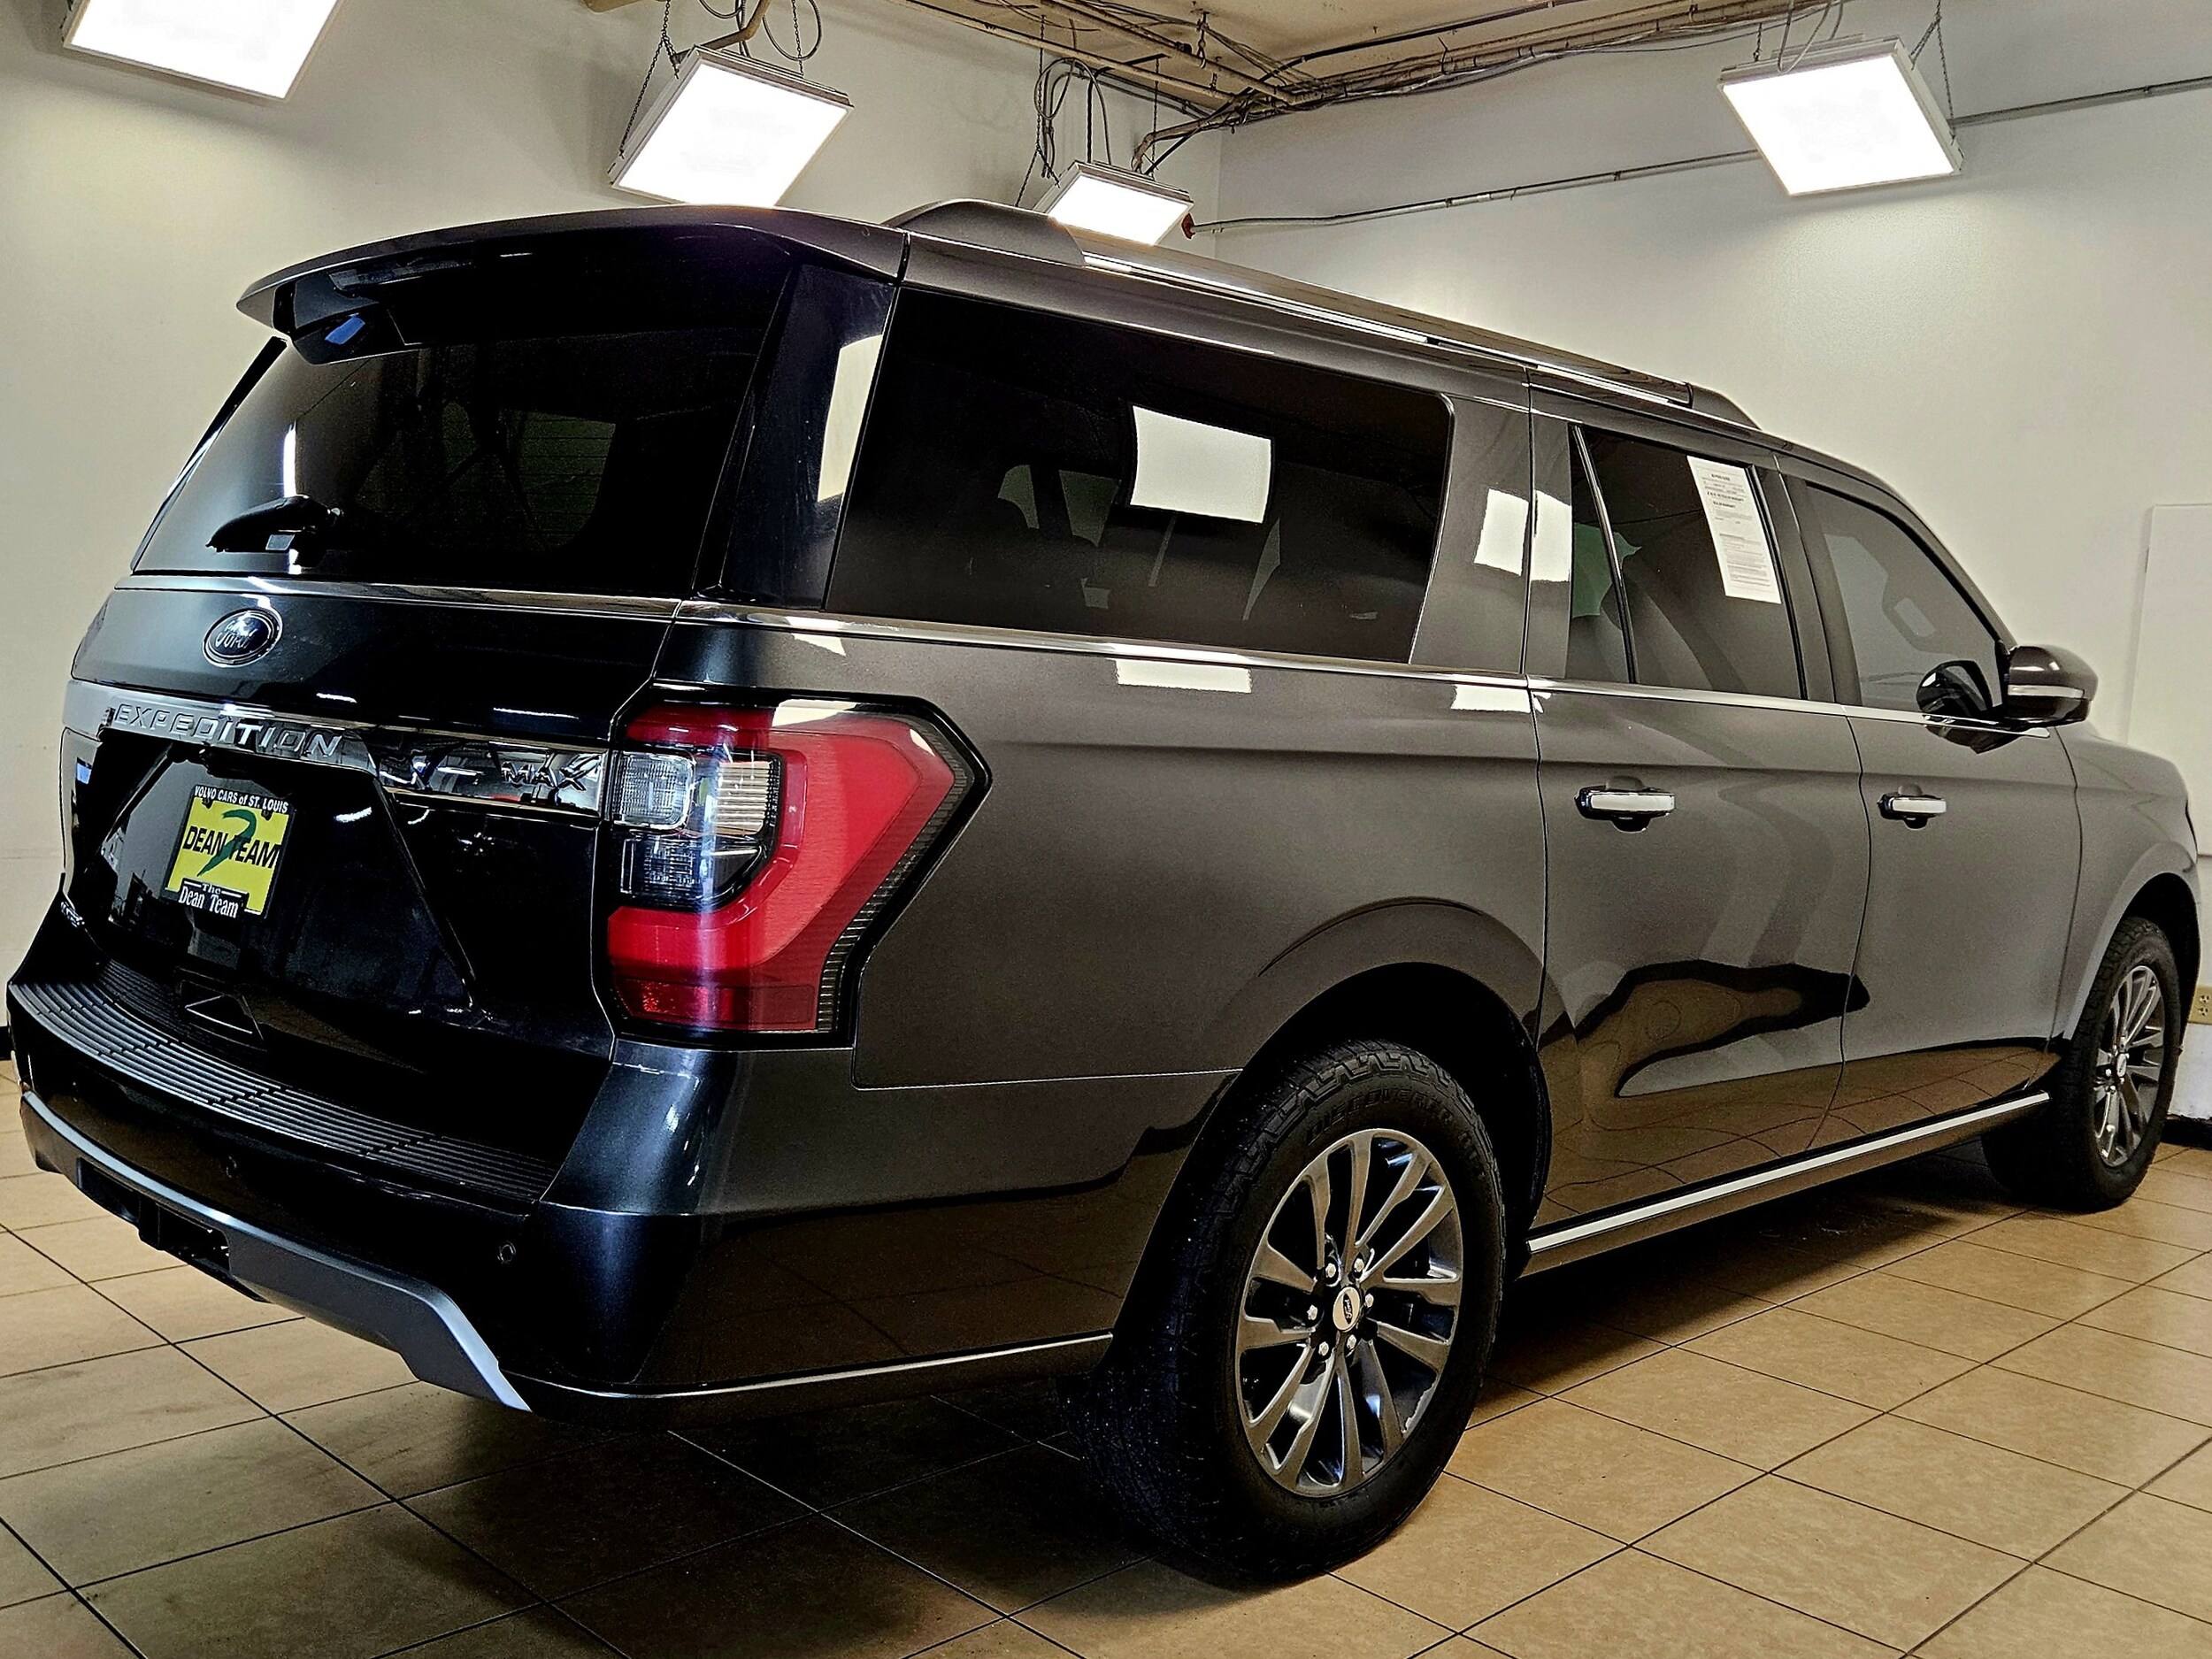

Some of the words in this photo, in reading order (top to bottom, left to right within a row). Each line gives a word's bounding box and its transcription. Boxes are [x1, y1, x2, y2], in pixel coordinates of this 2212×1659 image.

[215, 619, 258, 649] Ford
[114, 703, 342, 757] EXPEDITION
[501, 761, 587, 791] MAX
[195, 785, 217, 800] VOLVO
[218, 789, 238, 803] CARS
[238, 794, 249, 805] of
[249, 796, 261, 808] ST.
[262, 798, 289, 813] LOUIS
[182, 826, 228, 858] DEAN
[228, 835, 282, 869] TEAM
[178, 886, 205, 909] Dean
[210, 894, 239, 918] Team
[202, 883, 222, 895] The
